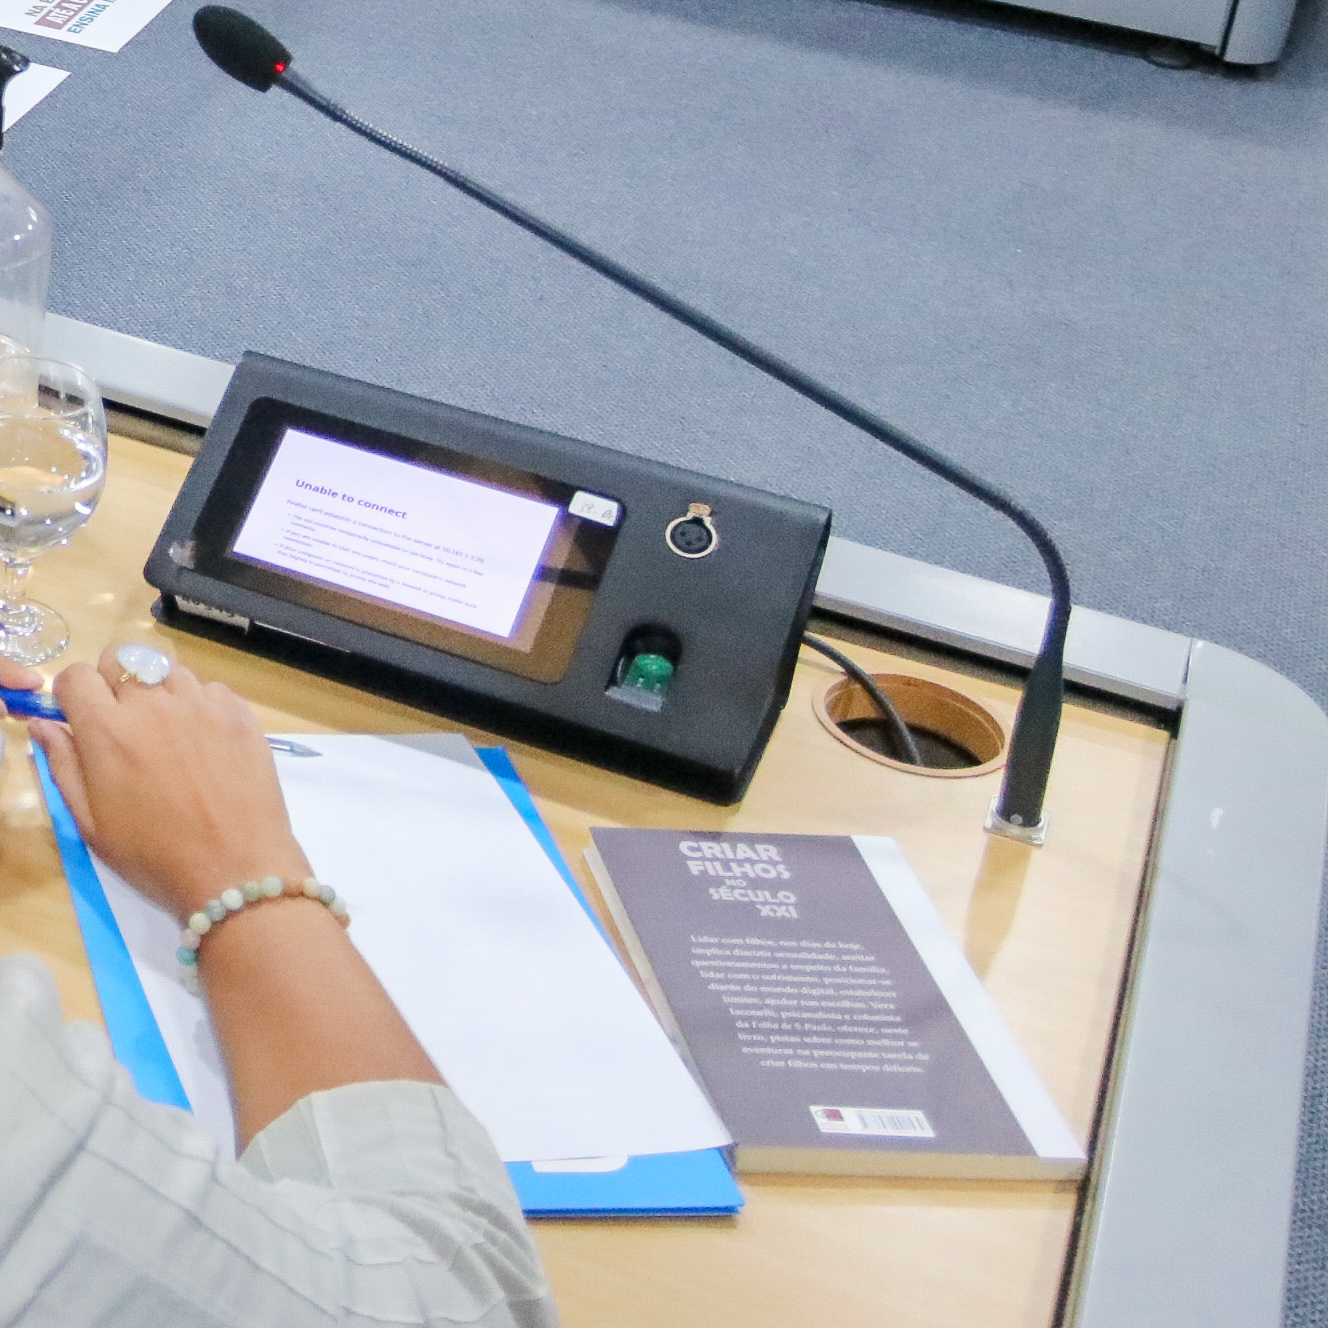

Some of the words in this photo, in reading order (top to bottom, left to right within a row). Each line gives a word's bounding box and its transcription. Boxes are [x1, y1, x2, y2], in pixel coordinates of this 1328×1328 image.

[25, 4, 47, 17] NA
[45, 7, 76, 25] ATÉ
[61, 2, 83, 11] A
[66, 3, 110, 34] ENSINA
[295, 479, 339, 499] Unable
[341, 493, 355, 503] to
[357, 498, 408, 520] connect
[679, 840, 782, 861] CRIAR
[686, 860, 791, 879] FILHOS
[725, 878, 747, 887] NO
[708, 884, 797, 903] SÉCULO
[755, 904, 799, 919] XXI
